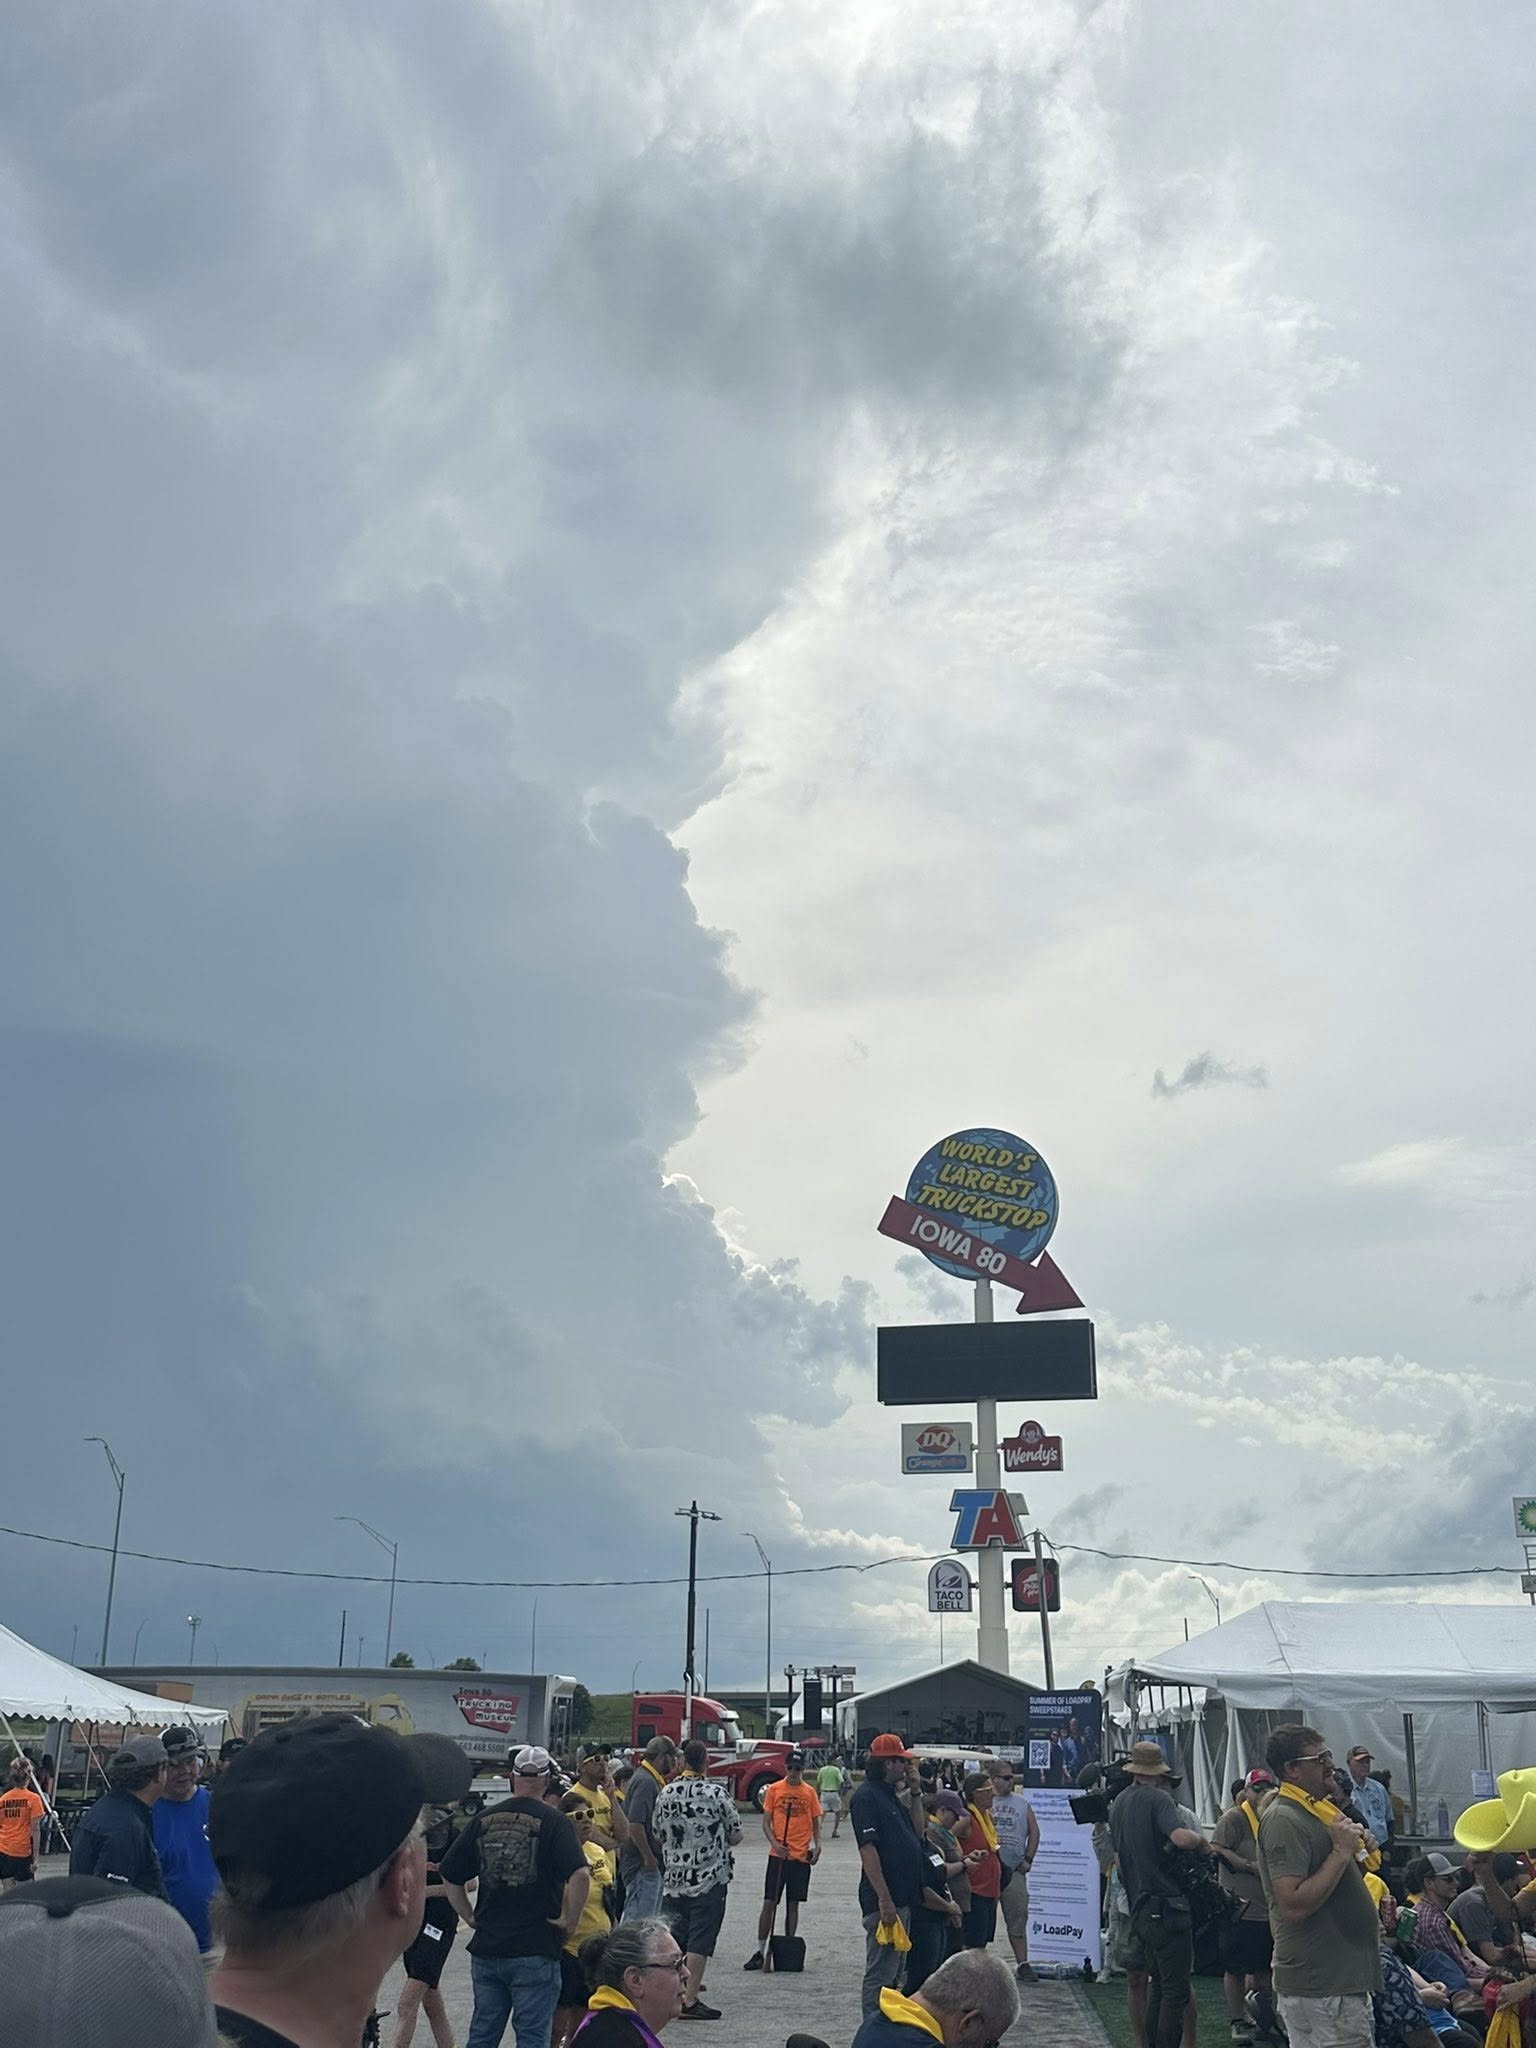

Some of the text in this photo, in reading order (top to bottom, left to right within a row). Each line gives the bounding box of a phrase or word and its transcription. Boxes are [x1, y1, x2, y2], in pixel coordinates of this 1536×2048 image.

[940, 1138, 1037, 1172] WORLD'S
[939, 1163, 1035, 1198] LARGEST
[917, 1185, 1049, 1230] TRUCKSTOP
[909, 1214, 1007, 1275] IOWA 80
[922, 1431, 950, 1448] DQ
[1006, 1444, 1058, 1467] Wendy's
[951, 1490, 1024, 1547] TA
[936, 1590, 964, 1600] TACO
[937, 1601, 963, 1610] BELL
[1029, 1696, 1093, 1705] SUMMER OF LOADPAY
[1029, 1705, 1073, 1714] SWEEPSTAKES
[1043, 1922, 1084, 1939] LoadPay
